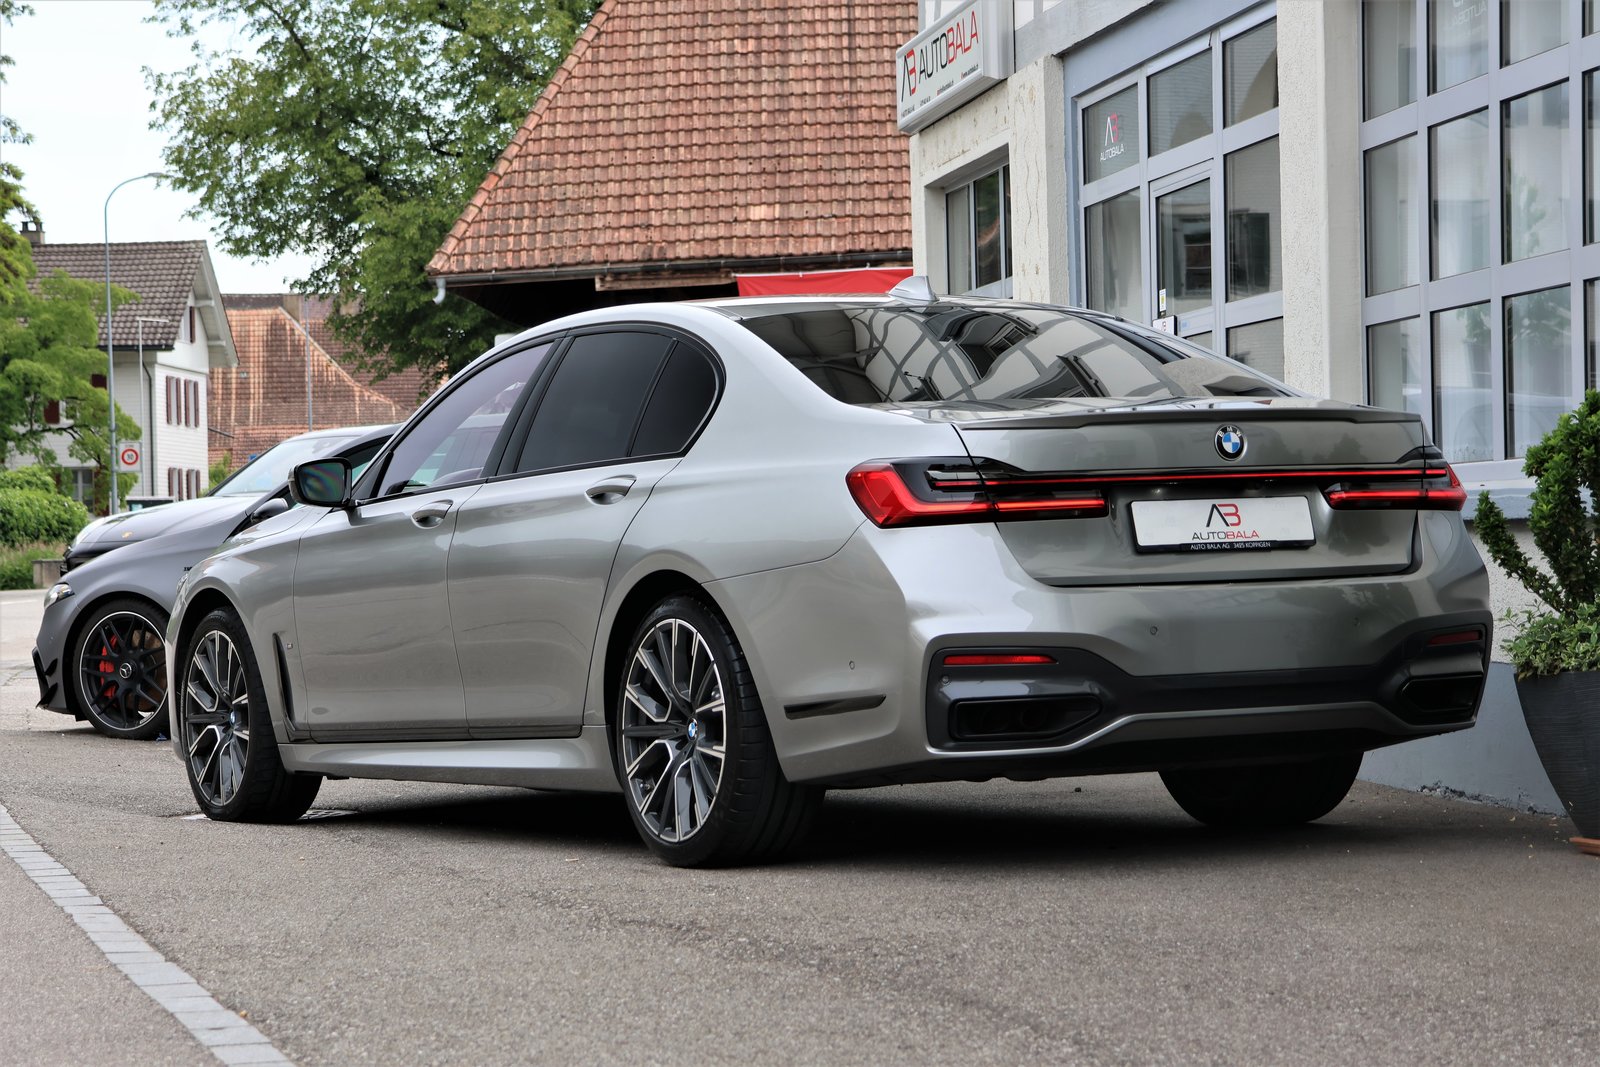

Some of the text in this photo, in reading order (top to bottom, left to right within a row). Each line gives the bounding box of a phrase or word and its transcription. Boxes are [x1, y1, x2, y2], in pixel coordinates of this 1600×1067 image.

[918, 10, 979, 84] AUTOBALA
[1100, 143, 1124, 162] AUTOBALA
[1191, 530, 1260, 541] AUTOBALA
